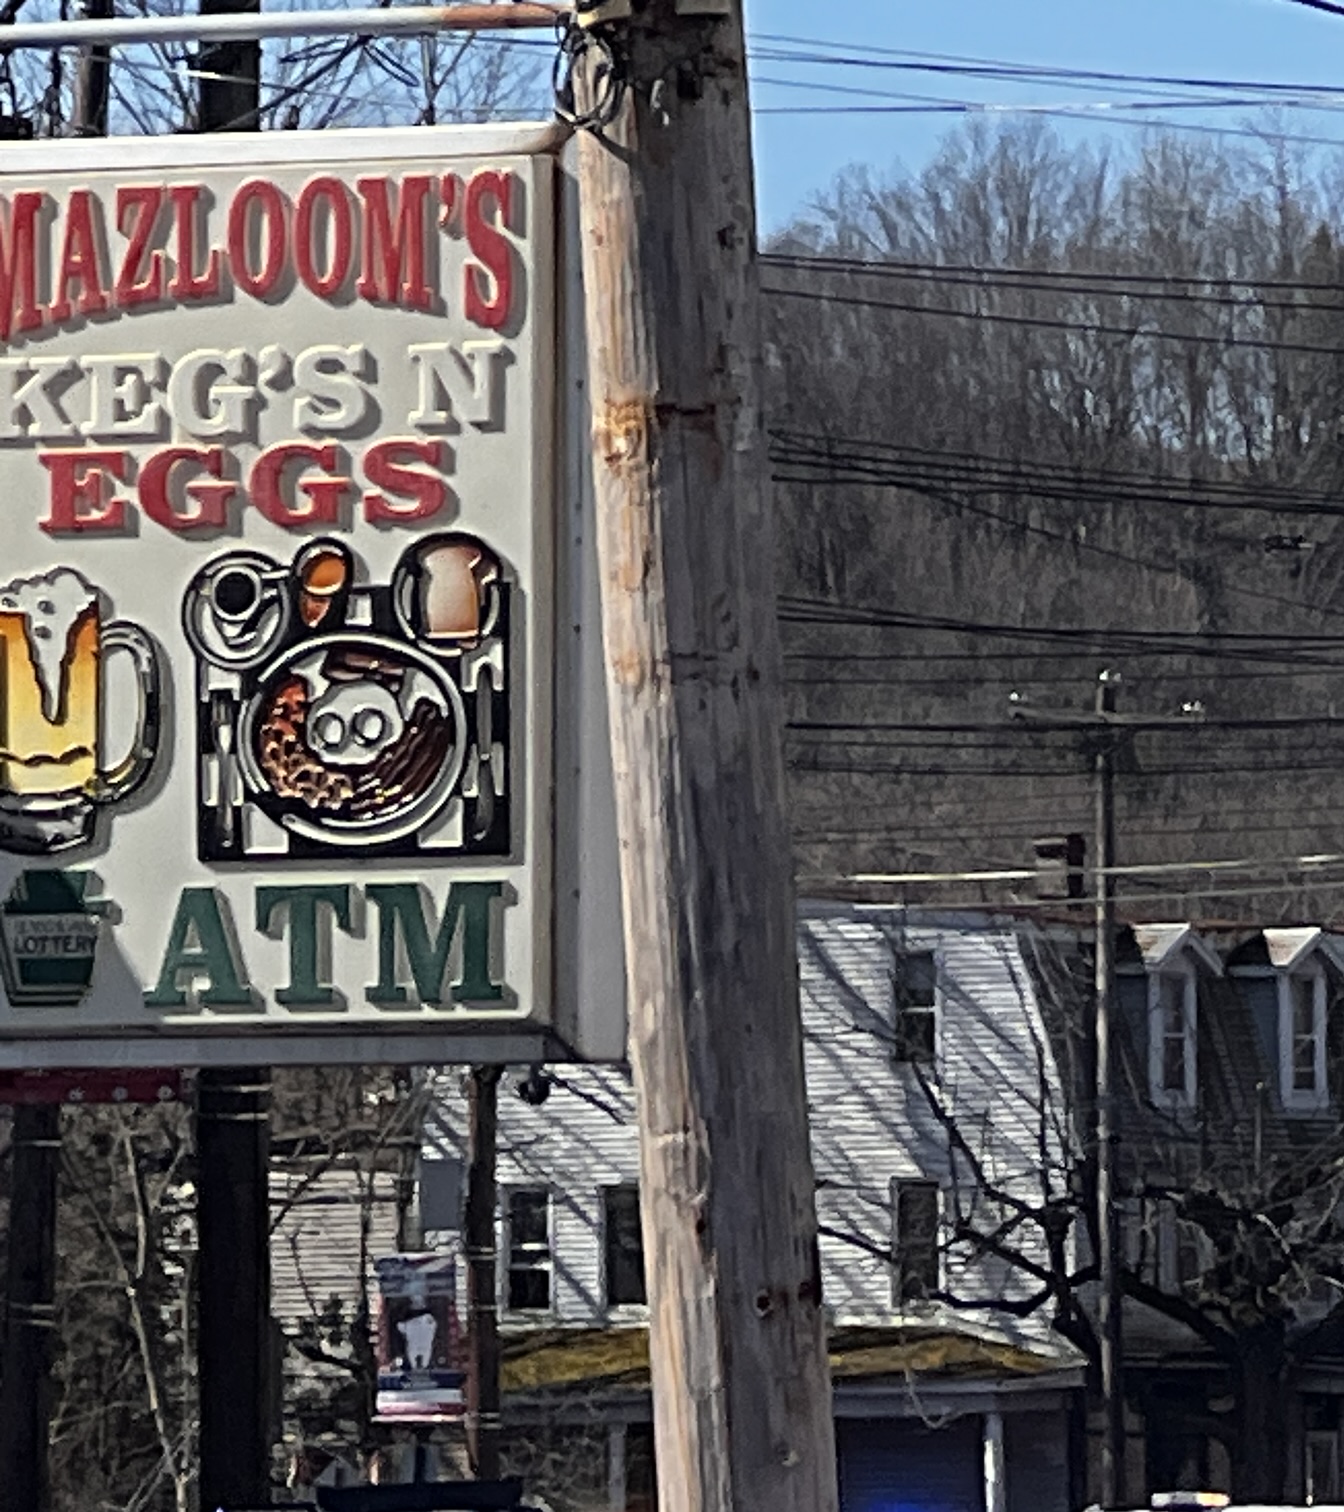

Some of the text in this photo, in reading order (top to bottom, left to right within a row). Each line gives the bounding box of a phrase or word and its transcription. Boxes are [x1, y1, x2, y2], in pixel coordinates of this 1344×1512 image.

[0, 168, 515, 340] MAZLOOM'S
[0, 339, 506, 437] KEG'S N
[38, 436, 448, 533] EGGS
[14, 935, 98, 954] LOTTERY
[143, 880, 505, 1009] ATM
